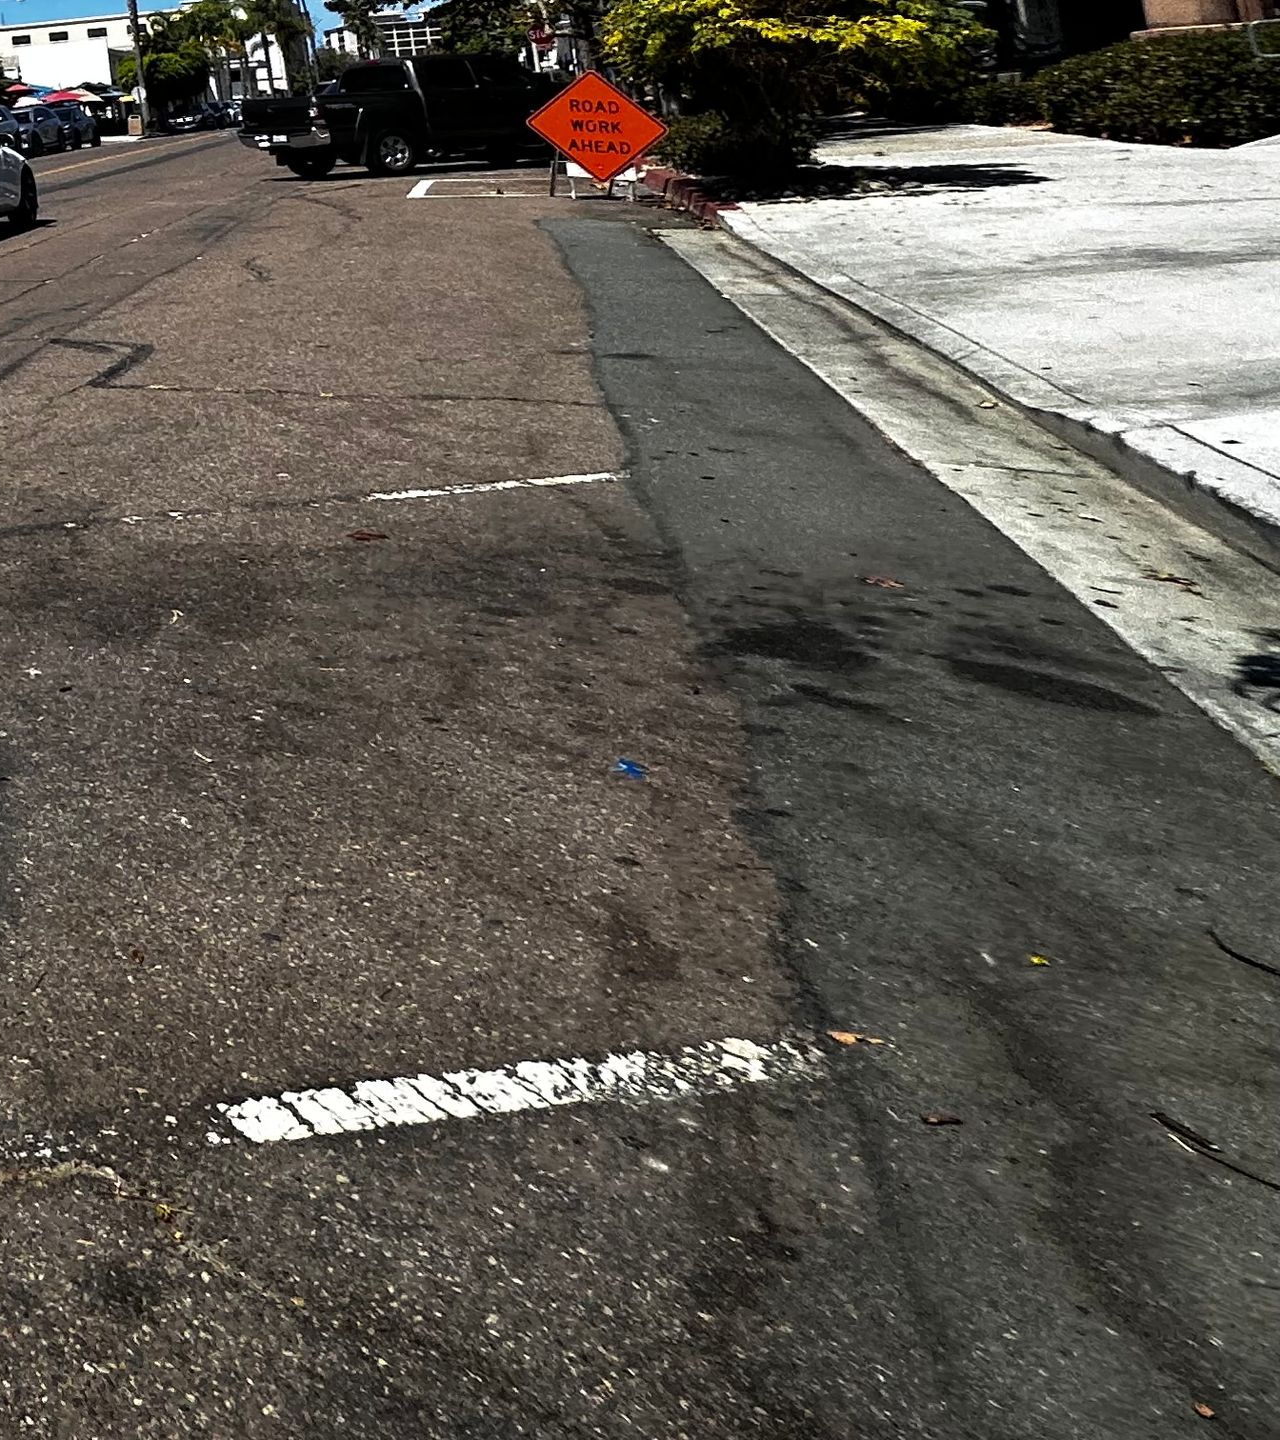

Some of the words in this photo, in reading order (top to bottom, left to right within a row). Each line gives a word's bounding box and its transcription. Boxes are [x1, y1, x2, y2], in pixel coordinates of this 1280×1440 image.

[528, 29, 552, 39] STO
[569, 99, 620, 114] ROAD
[571, 119, 623, 133] WORK
[568, 139, 631, 155] AHEAD
